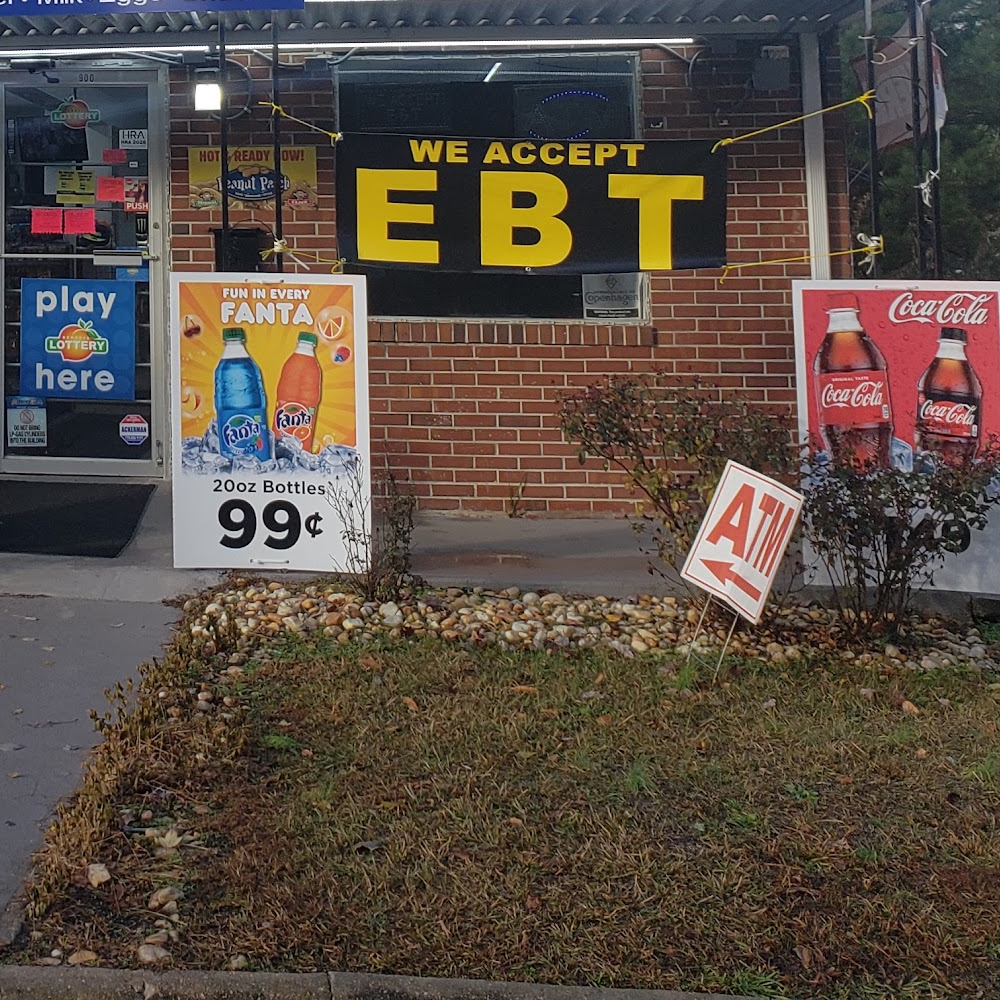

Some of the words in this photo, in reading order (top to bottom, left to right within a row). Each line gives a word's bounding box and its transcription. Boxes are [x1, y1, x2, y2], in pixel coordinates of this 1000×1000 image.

[54, 112, 98, 121] LOTTERY
[122, 130, 145, 139] HRA
[200, 150, 220, 162] HOT
[234, 150, 270, 162] READY
[281, 149, 304, 162] OW!
[409, 139, 469, 163] WE
[483, 141, 645, 167] ACCEPT
[260, 176, 290, 191] Pach
[126, 202, 149, 210] PUSH
[356, 167, 704, 270] EBT
[36, 286, 117, 319] play
[222, 287, 250, 299] FUN
[252, 288, 267, 299] IN
[270, 288, 310, 300] EVERY
[585, 292, 639, 305] Copenhagen
[221, 301, 313, 326] FANTA
[889, 292, 994, 325] Coca-Cola
[50, 340, 105, 351] LOTTERY
[36, 363, 115, 391] here
[822, 381, 883, 408] Coca-Cola
[276, 409, 311, 430] Fanta
[921, 399, 977, 425] Coca-Cola
[223, 420, 260, 446] Fanta
[213, 479, 257, 493] 20oz
[263, 479, 326, 495] Bottles
[705, 483, 795, 579] ATM
